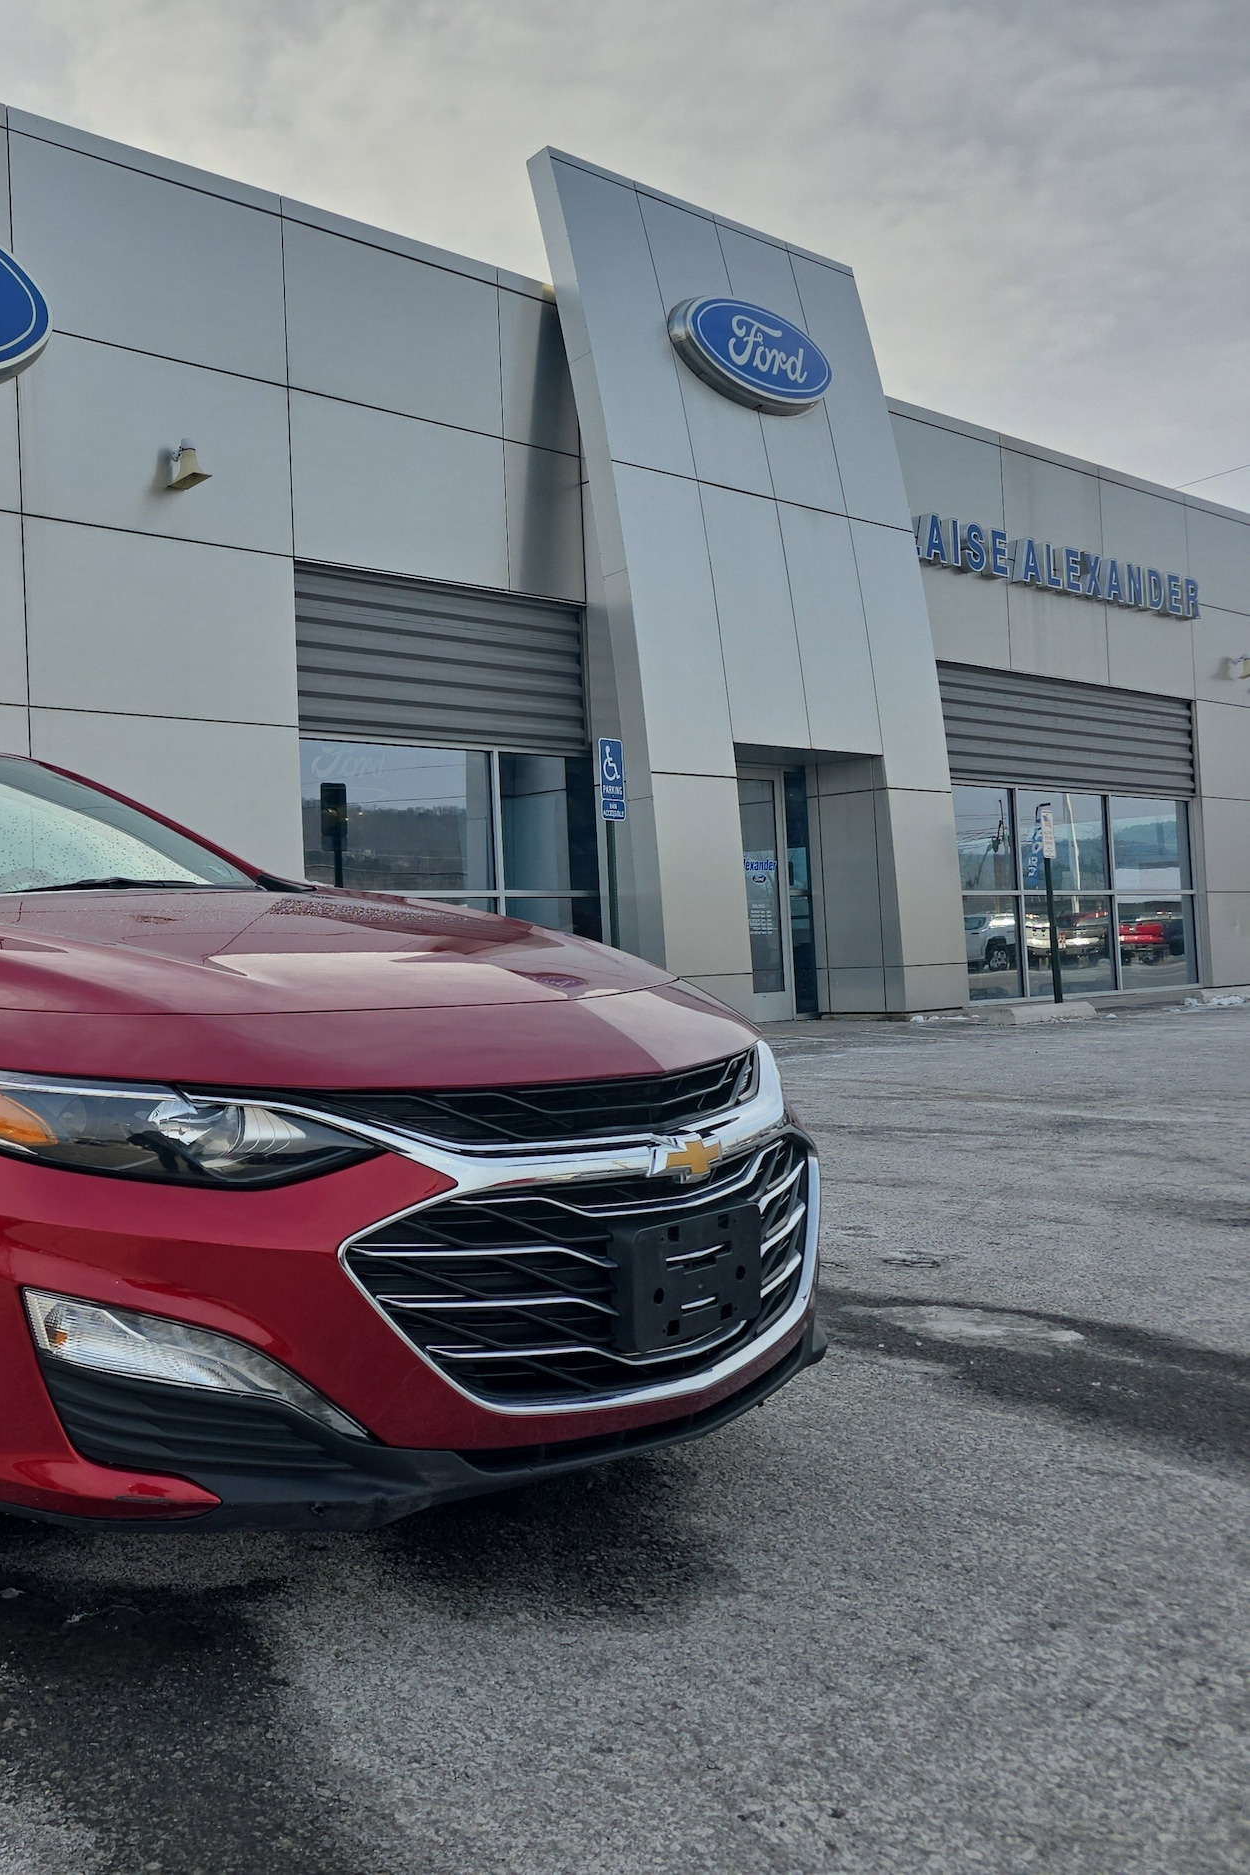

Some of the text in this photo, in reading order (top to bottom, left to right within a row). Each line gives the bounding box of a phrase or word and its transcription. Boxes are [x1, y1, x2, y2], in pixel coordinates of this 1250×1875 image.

[728, 315, 808, 384] Ford
[916, 512, 1201, 619] AISE ALEXANDER
[603, 785, 623, 796] PARKING
[743, 859, 777, 871] lexander
